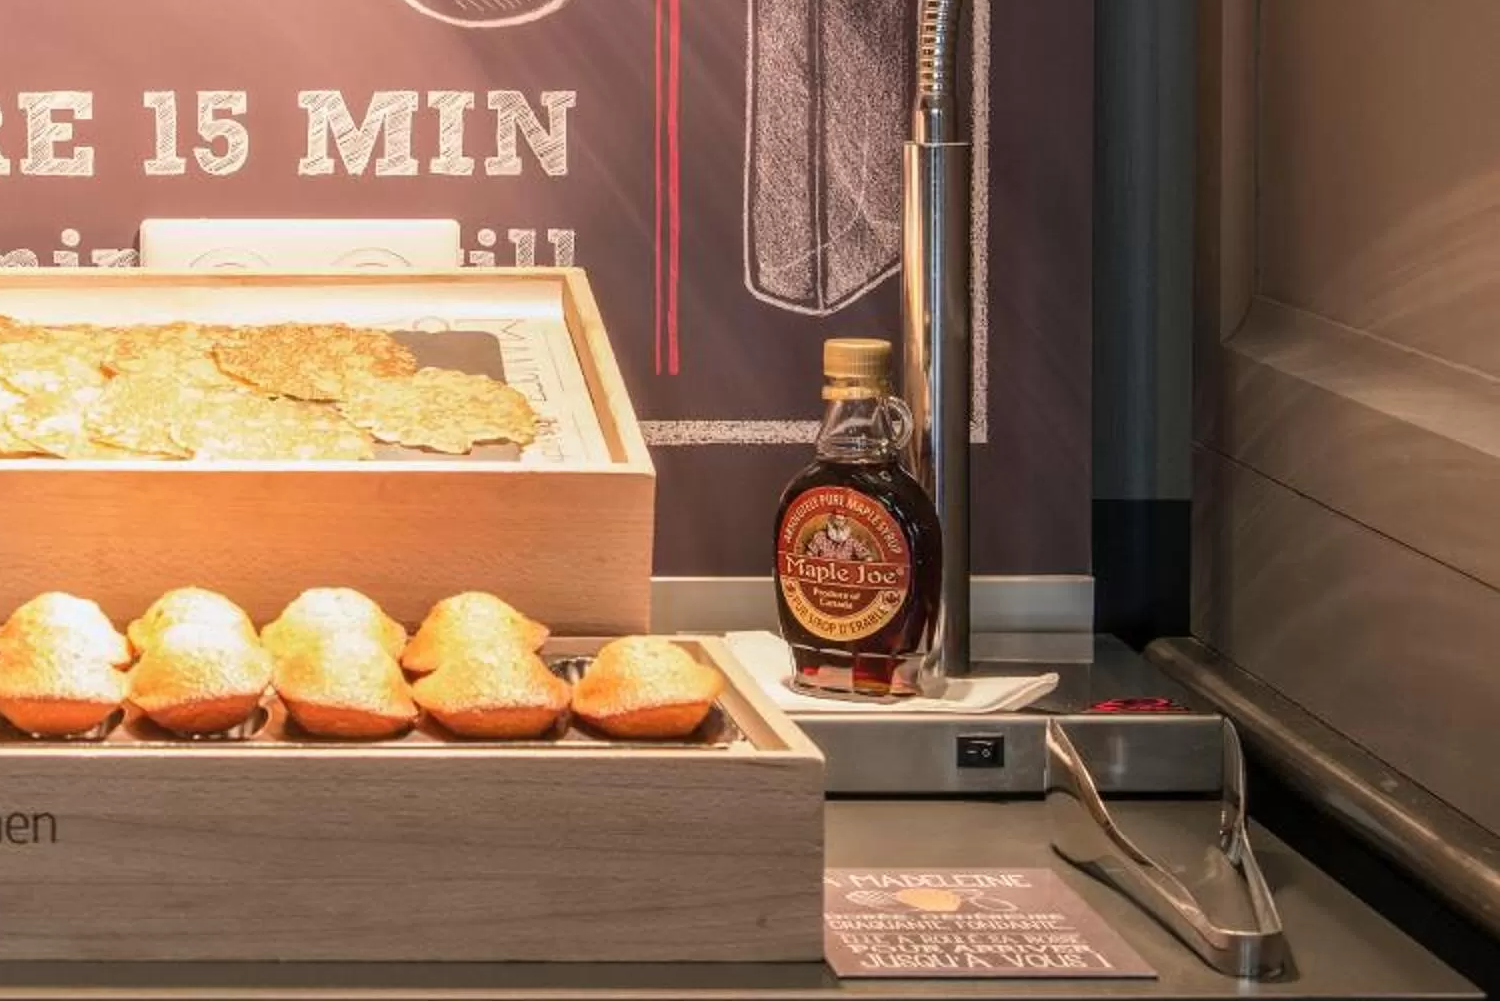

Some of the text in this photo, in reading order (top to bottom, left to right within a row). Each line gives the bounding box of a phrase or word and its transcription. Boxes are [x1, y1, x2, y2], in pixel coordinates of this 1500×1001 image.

[143, 90, 249, 176] 15
[298, 90, 577, 176] MIN
[786, 554, 849, 583] Maple
[847, 873, 1032, 888] MADELEINE
